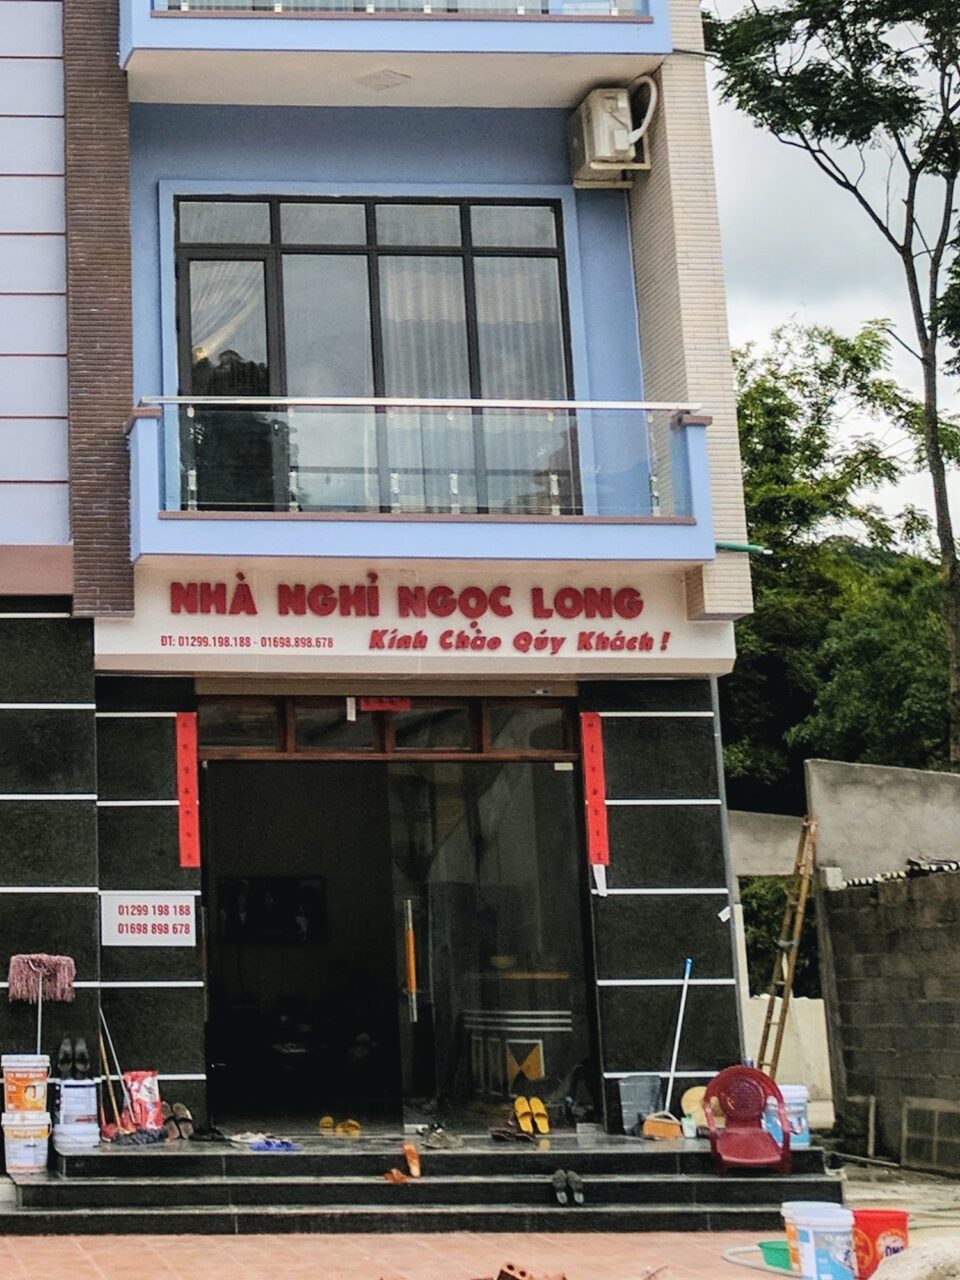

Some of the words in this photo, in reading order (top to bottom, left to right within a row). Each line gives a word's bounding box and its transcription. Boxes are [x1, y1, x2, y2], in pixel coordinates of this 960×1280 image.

[170, 572, 258, 615] NHÀ
[277, 572, 380, 617] NGHỈ
[397, 584, 514, 629] NGỌC
[530, 586, 644, 619] LONG
[178, 635, 252, 648] 01299.198.188
[368, 627, 429, 651] Kính
[438, 628, 503, 651] Chào
[577, 629, 654, 652] Khách
[117, 904, 149, 916] 01299
[151, 904, 170, 916] 198
[172, 904, 192, 916] 188
[117, 923, 148, 935] 01698
[150, 923, 170, 935] 898
[172, 923, 191, 935] 678
